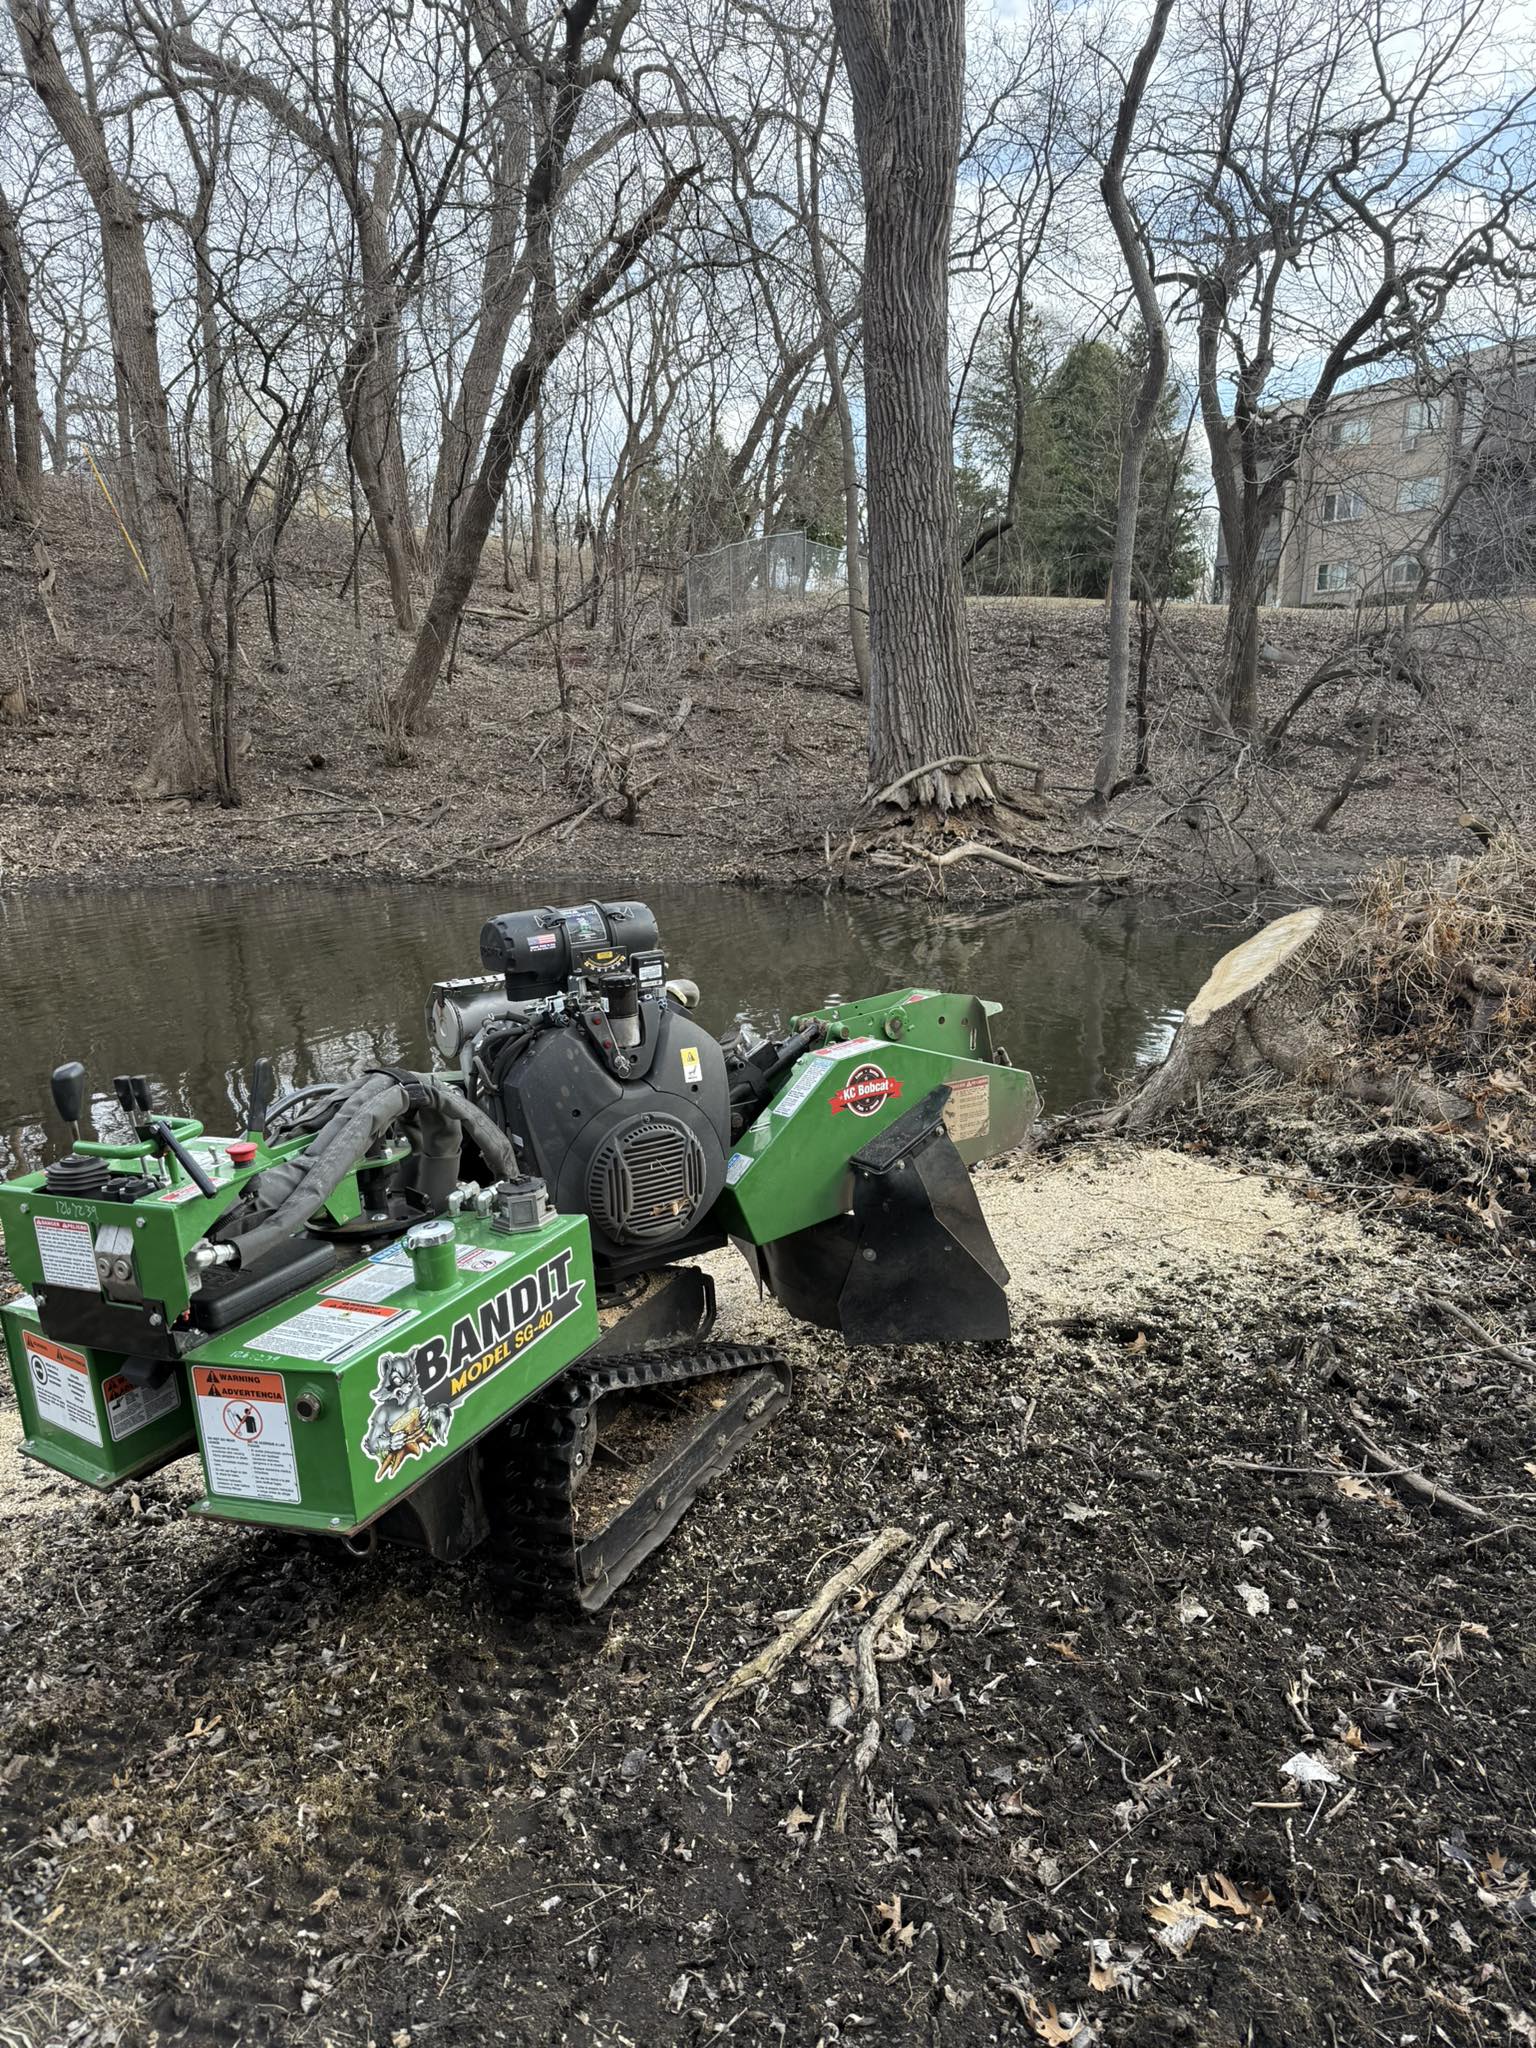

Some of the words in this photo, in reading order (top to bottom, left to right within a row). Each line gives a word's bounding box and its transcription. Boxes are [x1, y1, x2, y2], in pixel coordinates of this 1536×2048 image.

[843, 1087, 856, 1101] KC
[858, 1079, 889, 1097] Bobcat
[415, 1250, 572, 1393] BANDIT
[451, 1342, 511, 1396] MODEL
[514, 1310, 553, 1349] SG-40
[219, 1373, 261, 1384] WARNING
[222, 1388, 282, 1400] ADVERTENCIA
